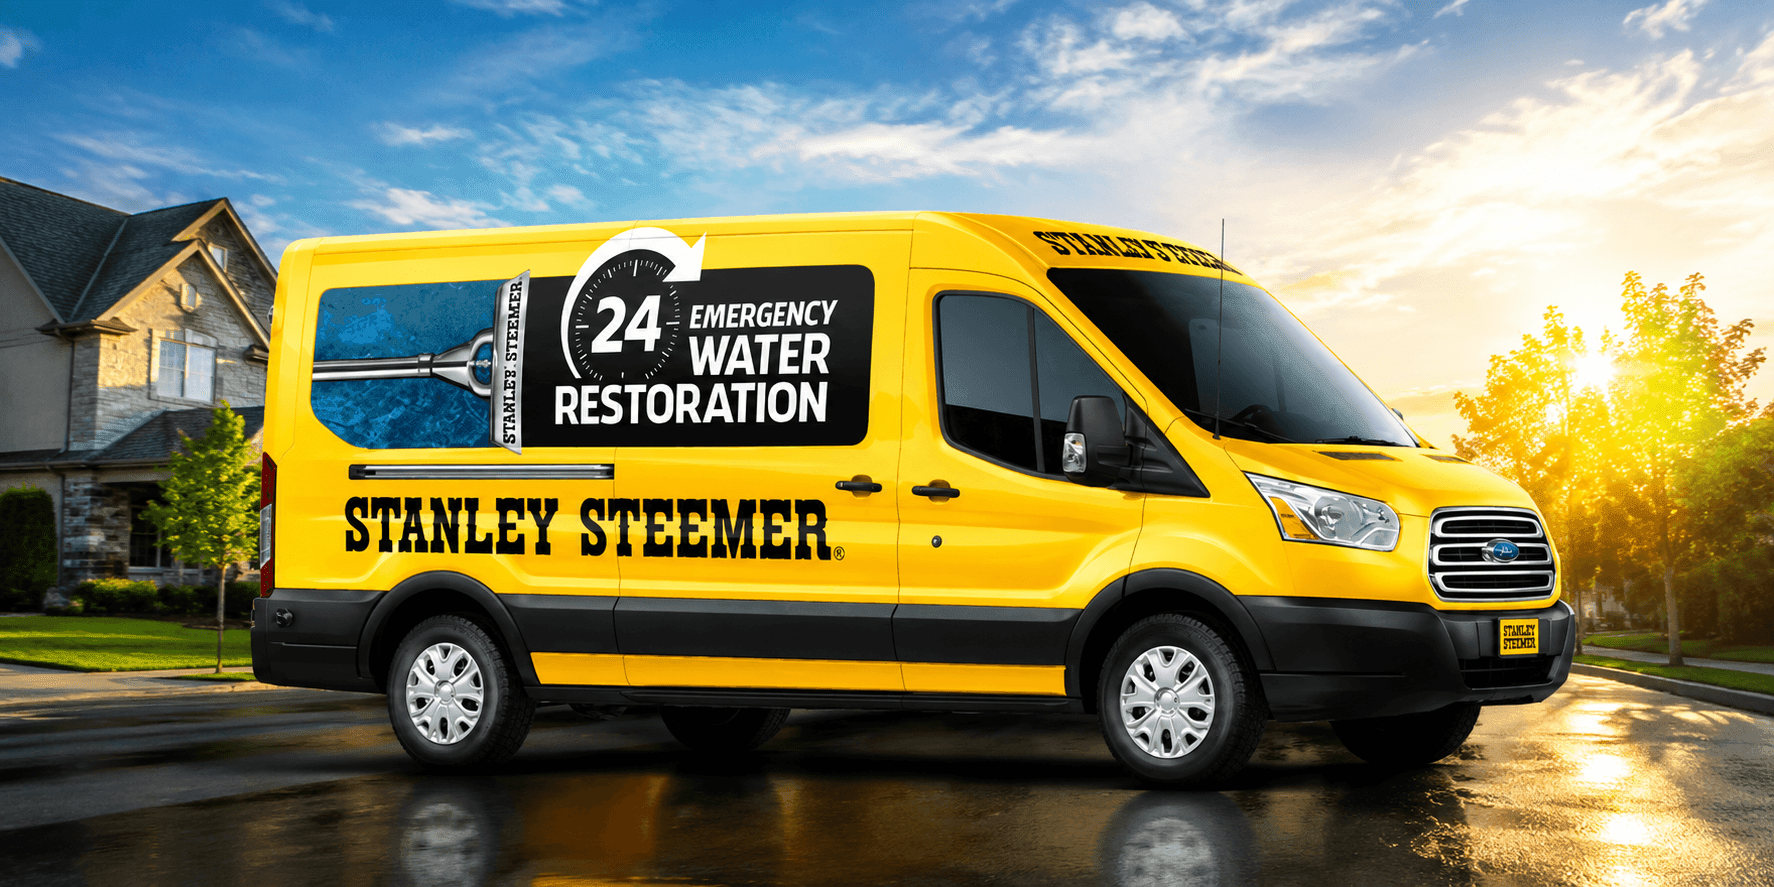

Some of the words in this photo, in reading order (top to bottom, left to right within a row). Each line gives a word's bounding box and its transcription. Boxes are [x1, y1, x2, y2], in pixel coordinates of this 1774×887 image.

[590, 294, 662, 354] 24
[689, 299, 839, 329] EMERGENCY
[688, 332, 832, 376] WATER
[554, 381, 829, 425] RESTORATION
[344, 496, 559, 556] STANLEY
[1503, 624, 1536, 637] STANLEY
